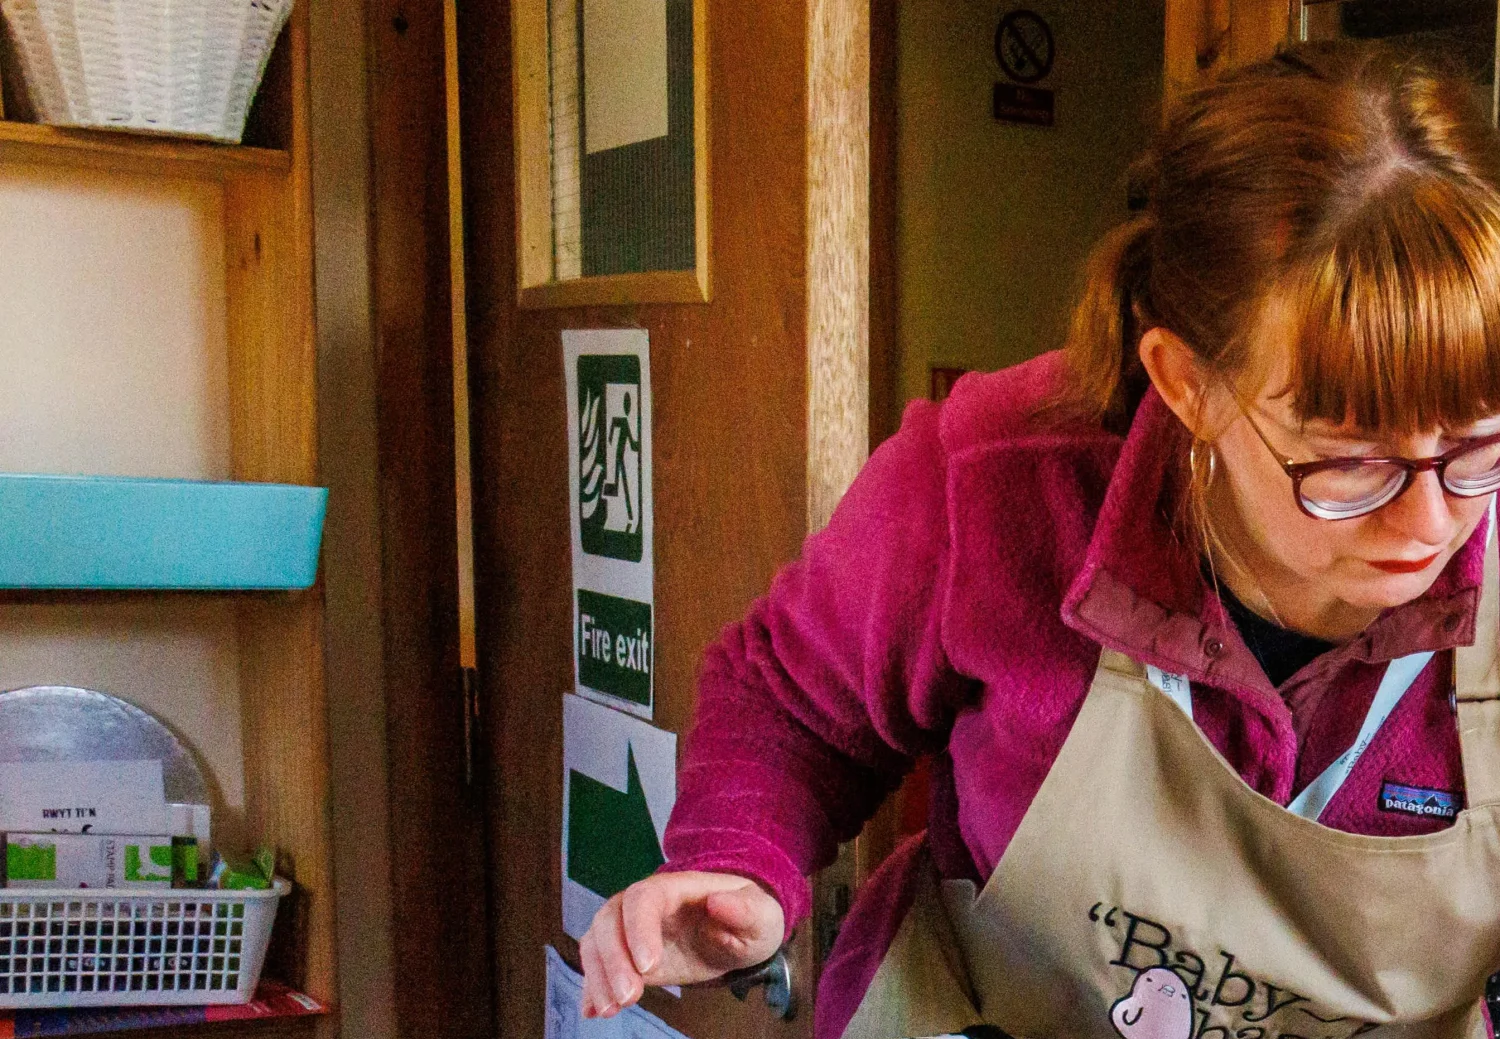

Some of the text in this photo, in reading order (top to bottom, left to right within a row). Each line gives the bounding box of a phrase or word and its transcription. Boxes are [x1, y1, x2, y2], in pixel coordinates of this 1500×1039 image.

[581, 613, 650, 674] Fire exit
[1385, 798, 1455, 818] patagonia
